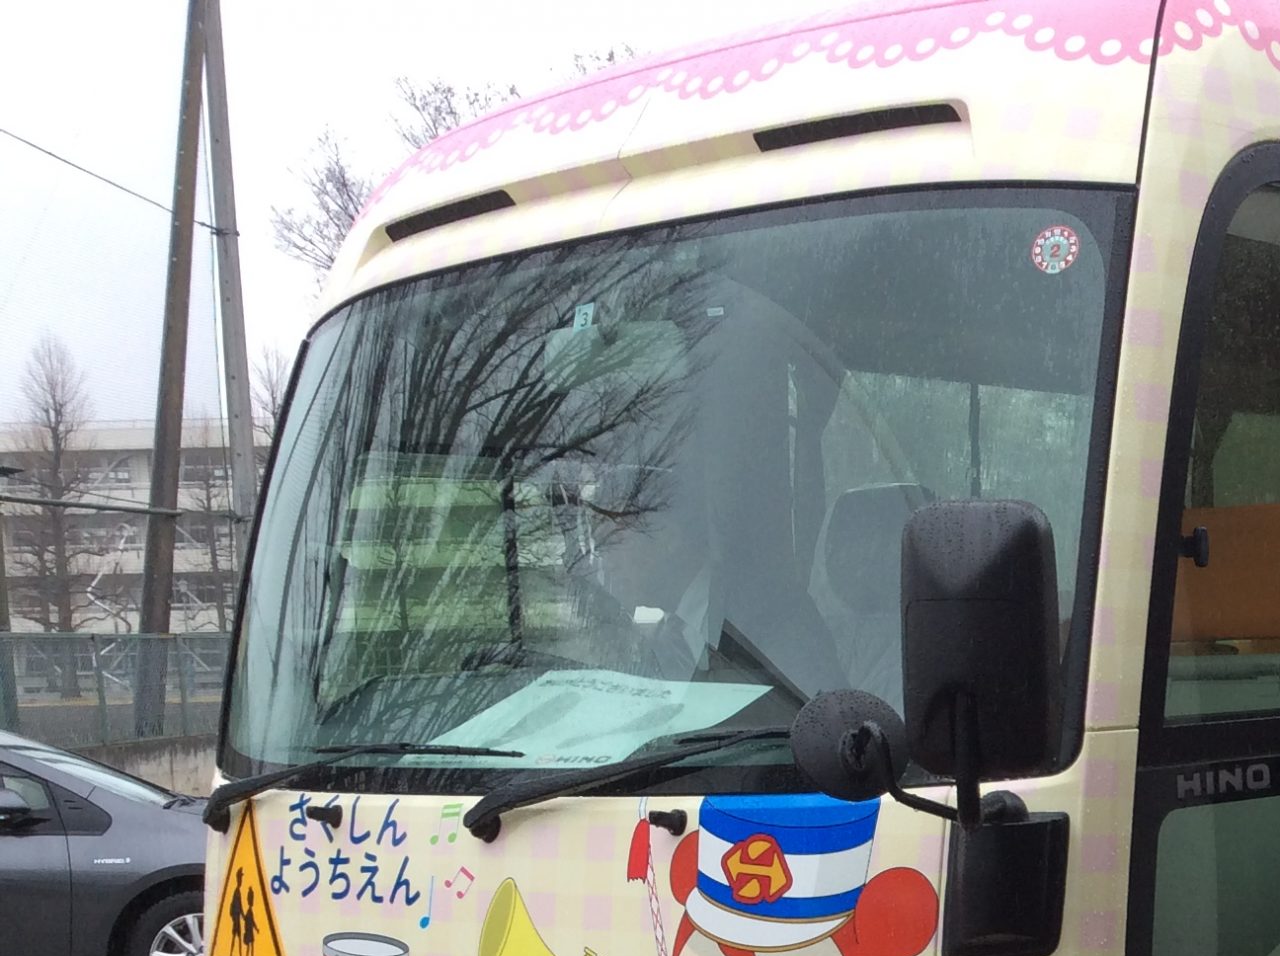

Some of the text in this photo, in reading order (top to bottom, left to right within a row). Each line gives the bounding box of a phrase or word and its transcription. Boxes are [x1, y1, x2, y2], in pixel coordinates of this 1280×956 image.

[556, 755, 612, 765] HINO
[1176, 763, 1271, 798] HINO
[270, 845, 420, 906] ようちえん
